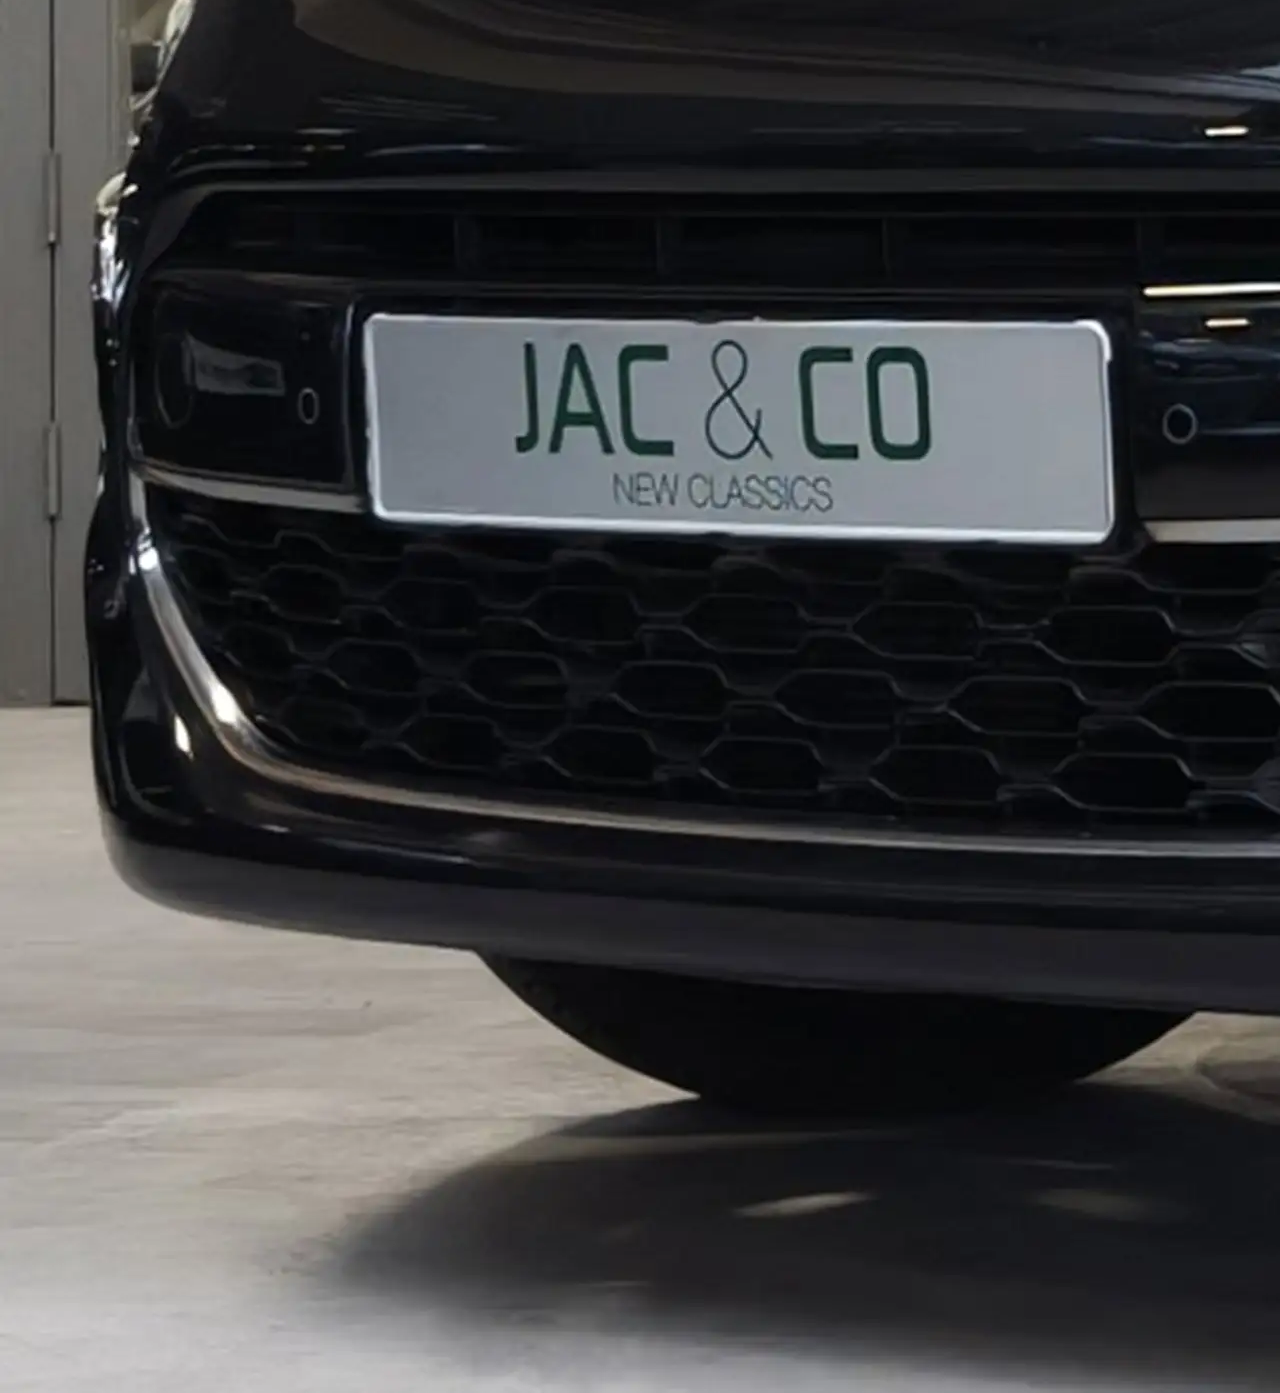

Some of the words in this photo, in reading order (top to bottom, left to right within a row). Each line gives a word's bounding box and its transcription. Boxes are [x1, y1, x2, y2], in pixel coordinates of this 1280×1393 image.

[515, 343, 675, 457] JAC
[705, 340, 773, 460] &
[799, 346, 931, 461] CO
[613, 472, 679, 509] NEW
[688, 473, 833, 512] CLASSICS
